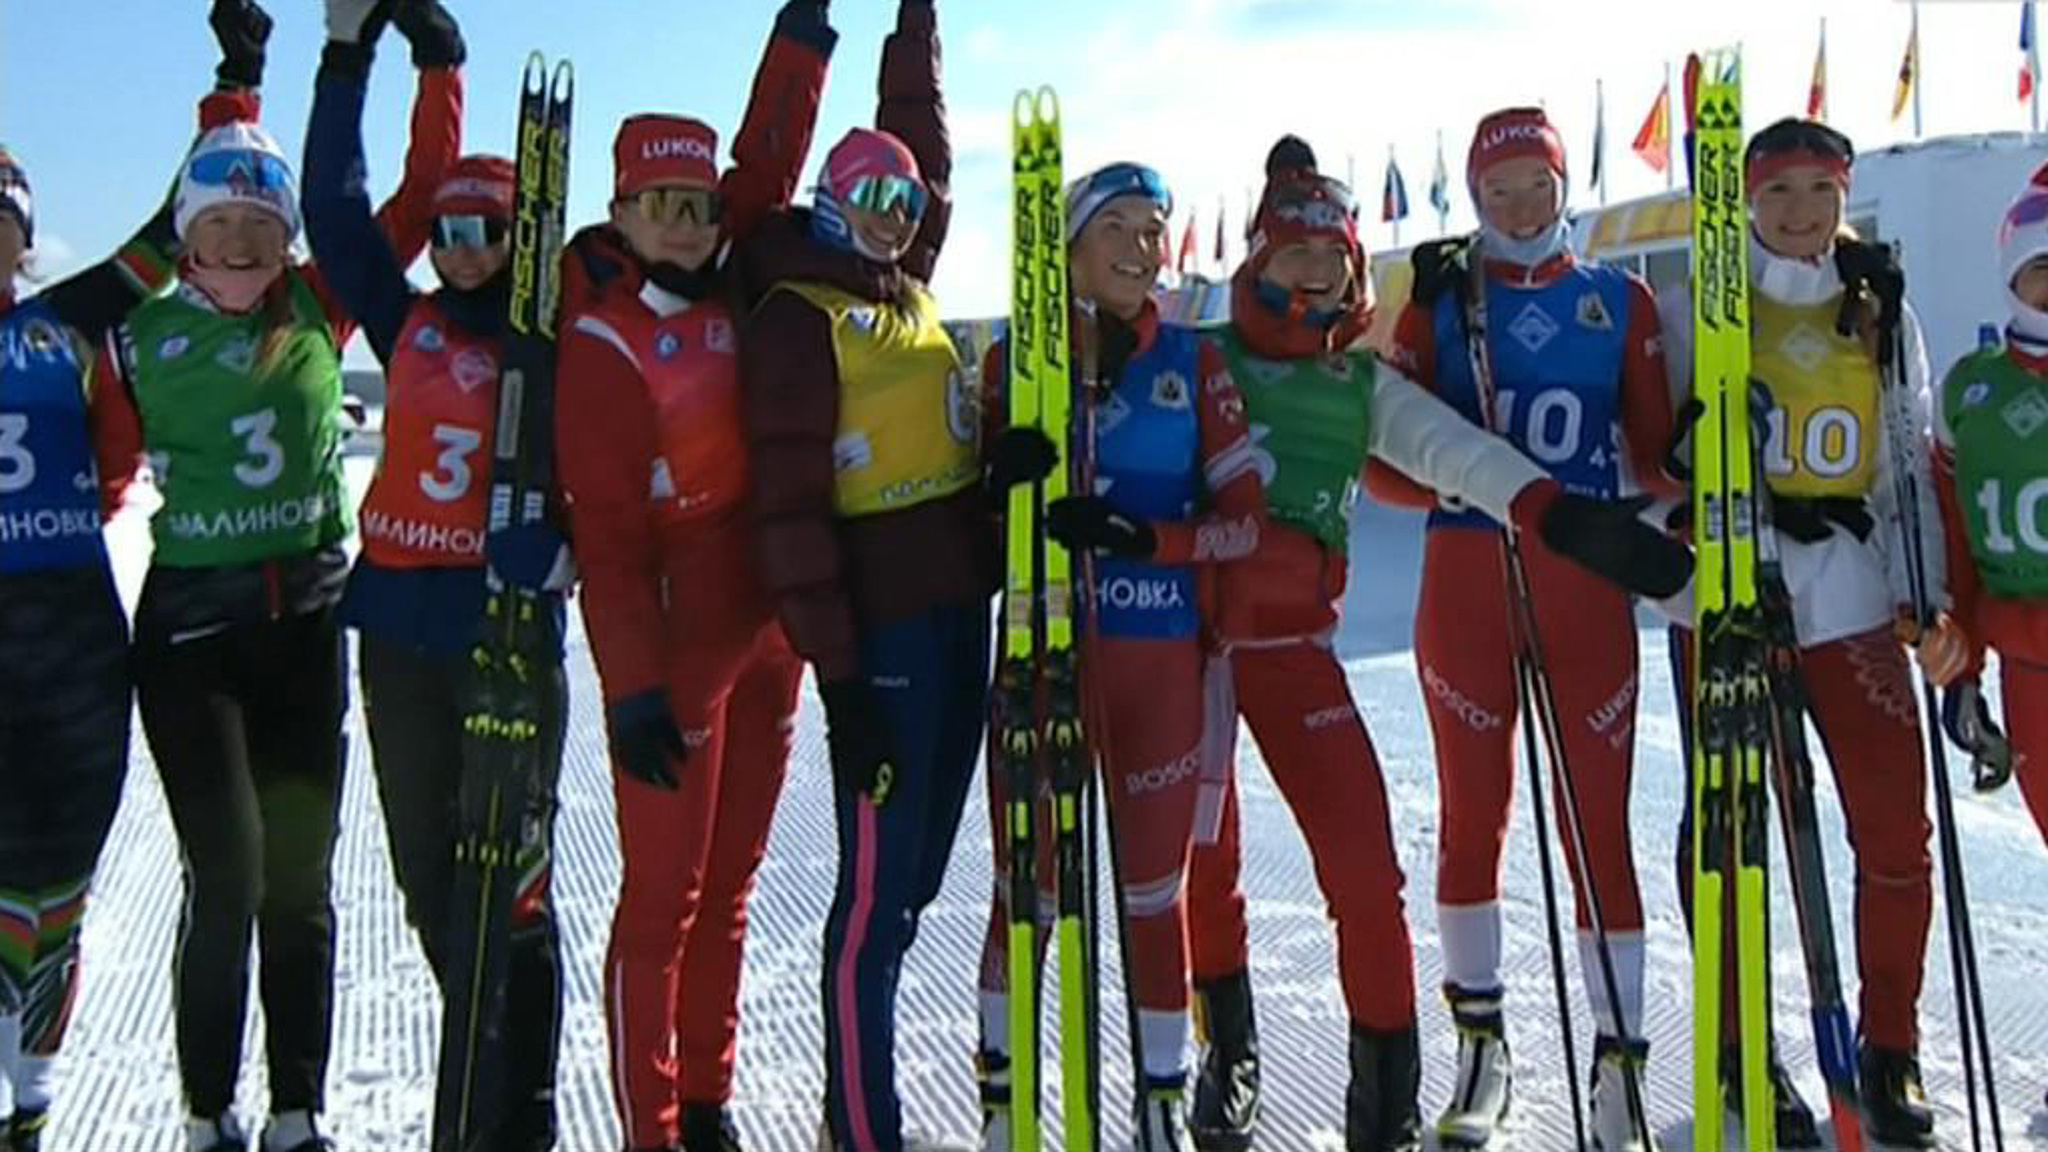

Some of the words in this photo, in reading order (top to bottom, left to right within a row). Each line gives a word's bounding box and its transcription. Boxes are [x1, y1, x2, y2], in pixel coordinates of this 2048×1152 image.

[509, 116, 544, 335] FISCHER
[1015, 185, 1035, 382] FISCHER
[1040, 178, 1063, 371] FISCHER
[1699, 140, 1720, 333] FISCHER
[1721, 140, 1743, 330] FISCHER
[0, 412, 36, 493] 3
[231, 406, 285, 488] 3
[418, 423, 482, 500] 3
[1764, 407, 1860, 477] 10
